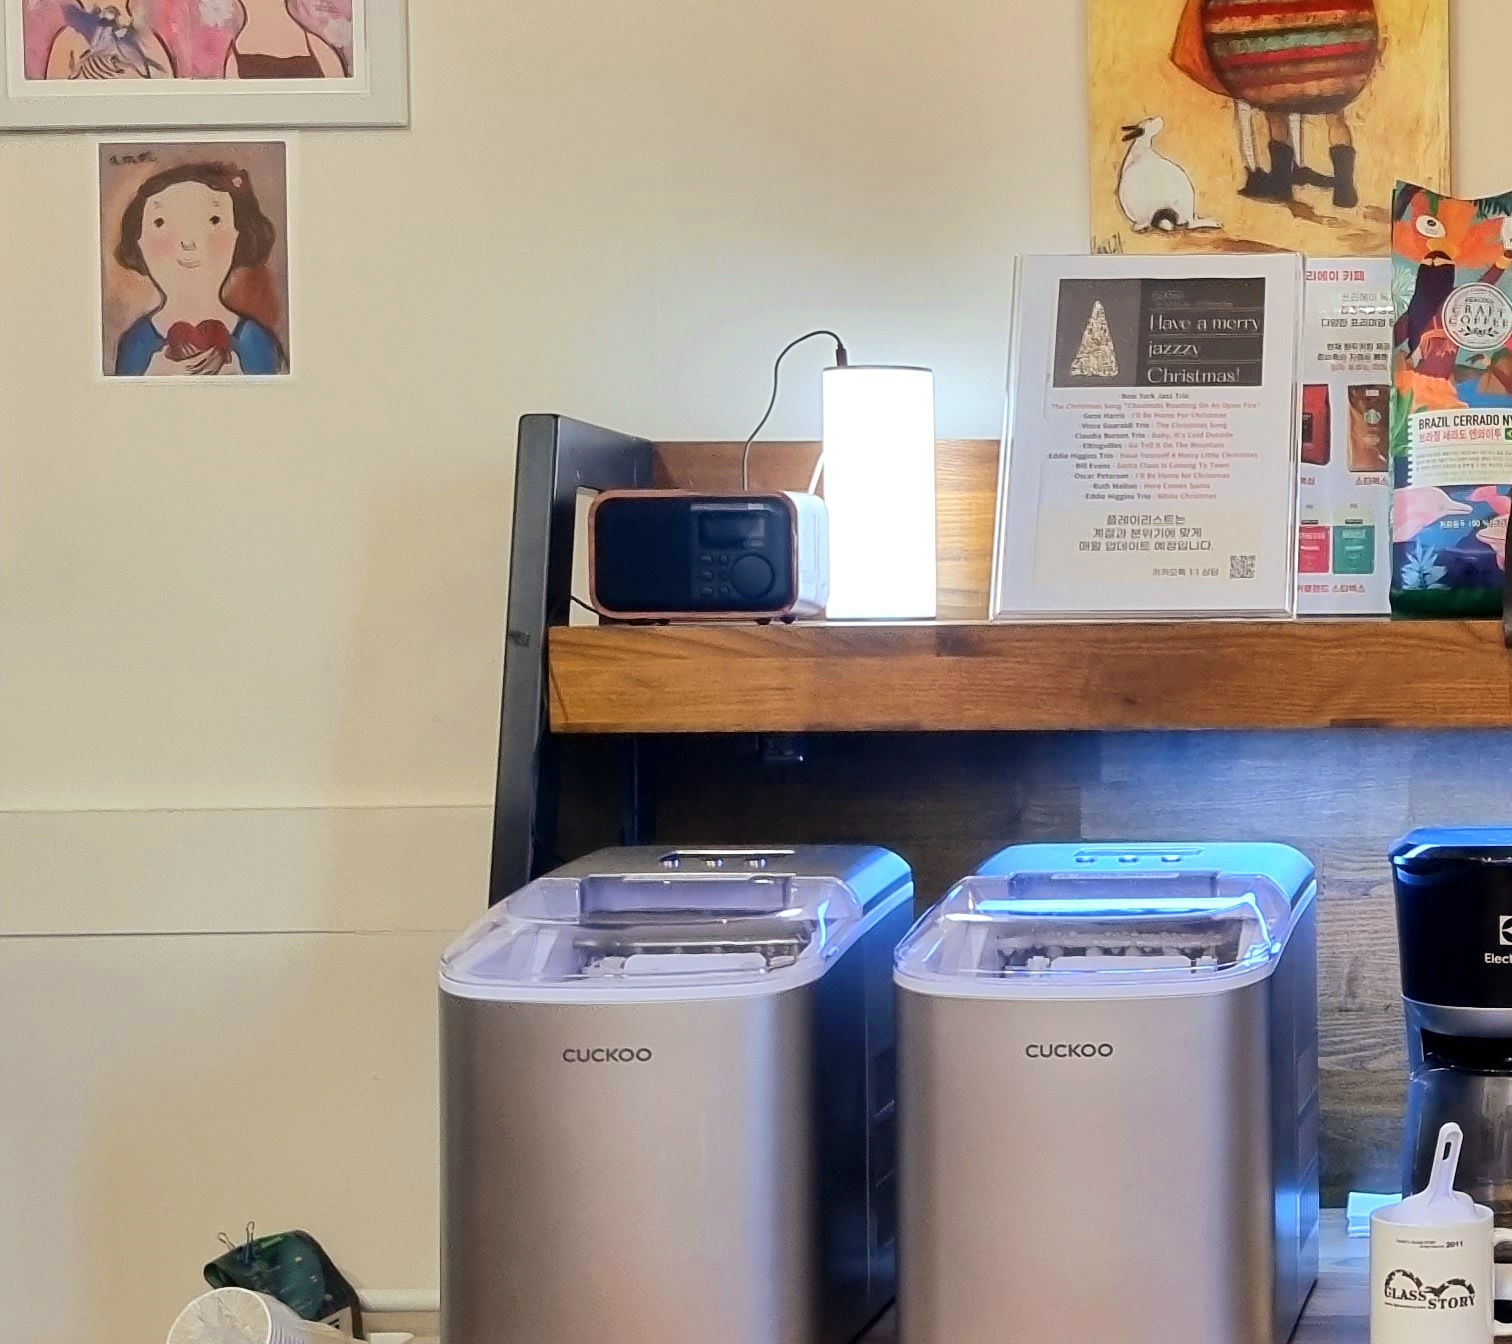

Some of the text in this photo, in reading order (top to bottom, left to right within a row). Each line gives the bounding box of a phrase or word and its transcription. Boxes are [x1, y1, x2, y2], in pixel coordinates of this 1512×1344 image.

[1149, 314, 1260, 332] Have a merry
[1147, 366, 1240, 384] Christmas!
[1418, 415, 1450, 430] BRAZIL
[1453, 414, 1500, 427] CERRADO
[1106, 514, 1186, 526] 플레이리스트는
[1105, 540, 1150, 552] 업데이트
[562, 1047, 653, 1062] CUCKOO
[1025, 1043, 1114, 1058] CUCKOO
[1384, 1286, 1427, 1302] GLASS
[1427, 1294, 1476, 1310] STORY
